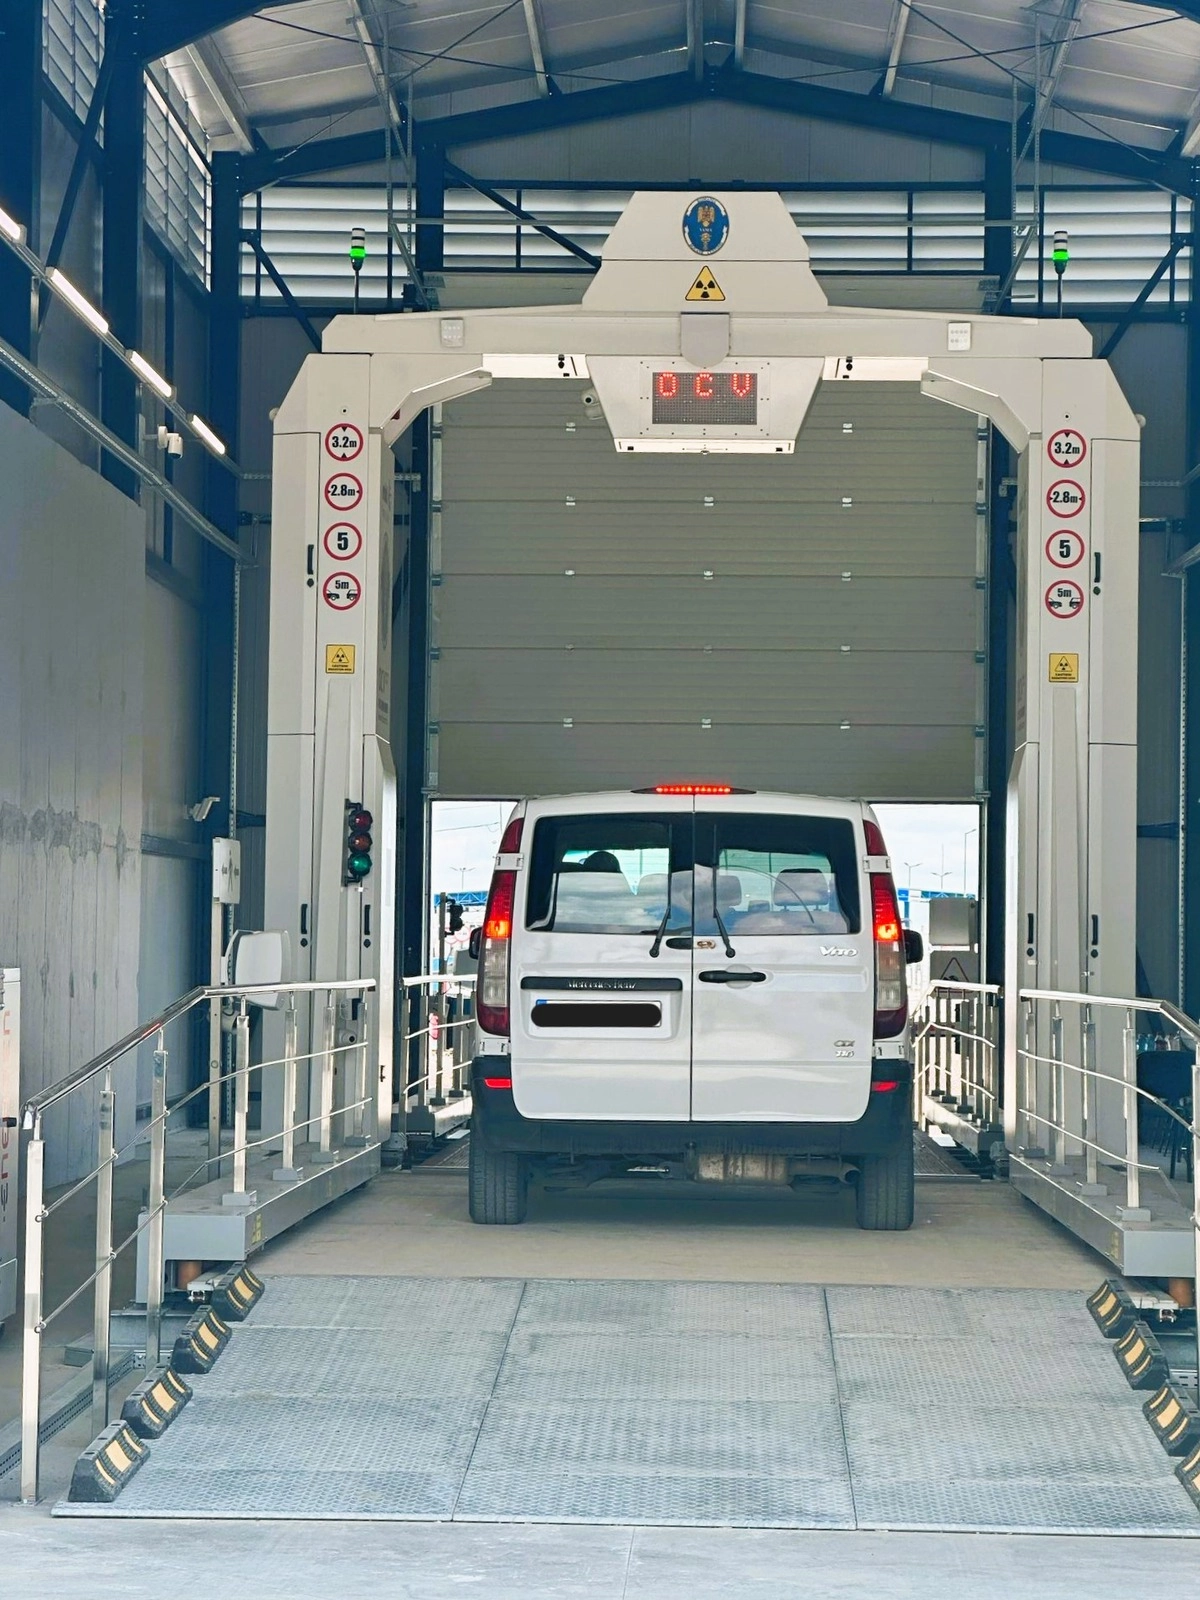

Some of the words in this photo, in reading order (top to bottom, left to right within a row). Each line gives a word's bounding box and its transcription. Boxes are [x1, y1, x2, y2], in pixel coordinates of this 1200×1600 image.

[331, 436, 357, 448] 3.2m
[1054, 442, 1080, 454] 3.2m
[330, 484, 356, 496] 2.8m
[1052, 491, 1078, 503] 2.8m
[337, 532, 349, 551] 5
[1059, 539, 1071, 559] 5
[335, 580, 349, 590] 5m
[1057, 588, 1072, 598] 5m
